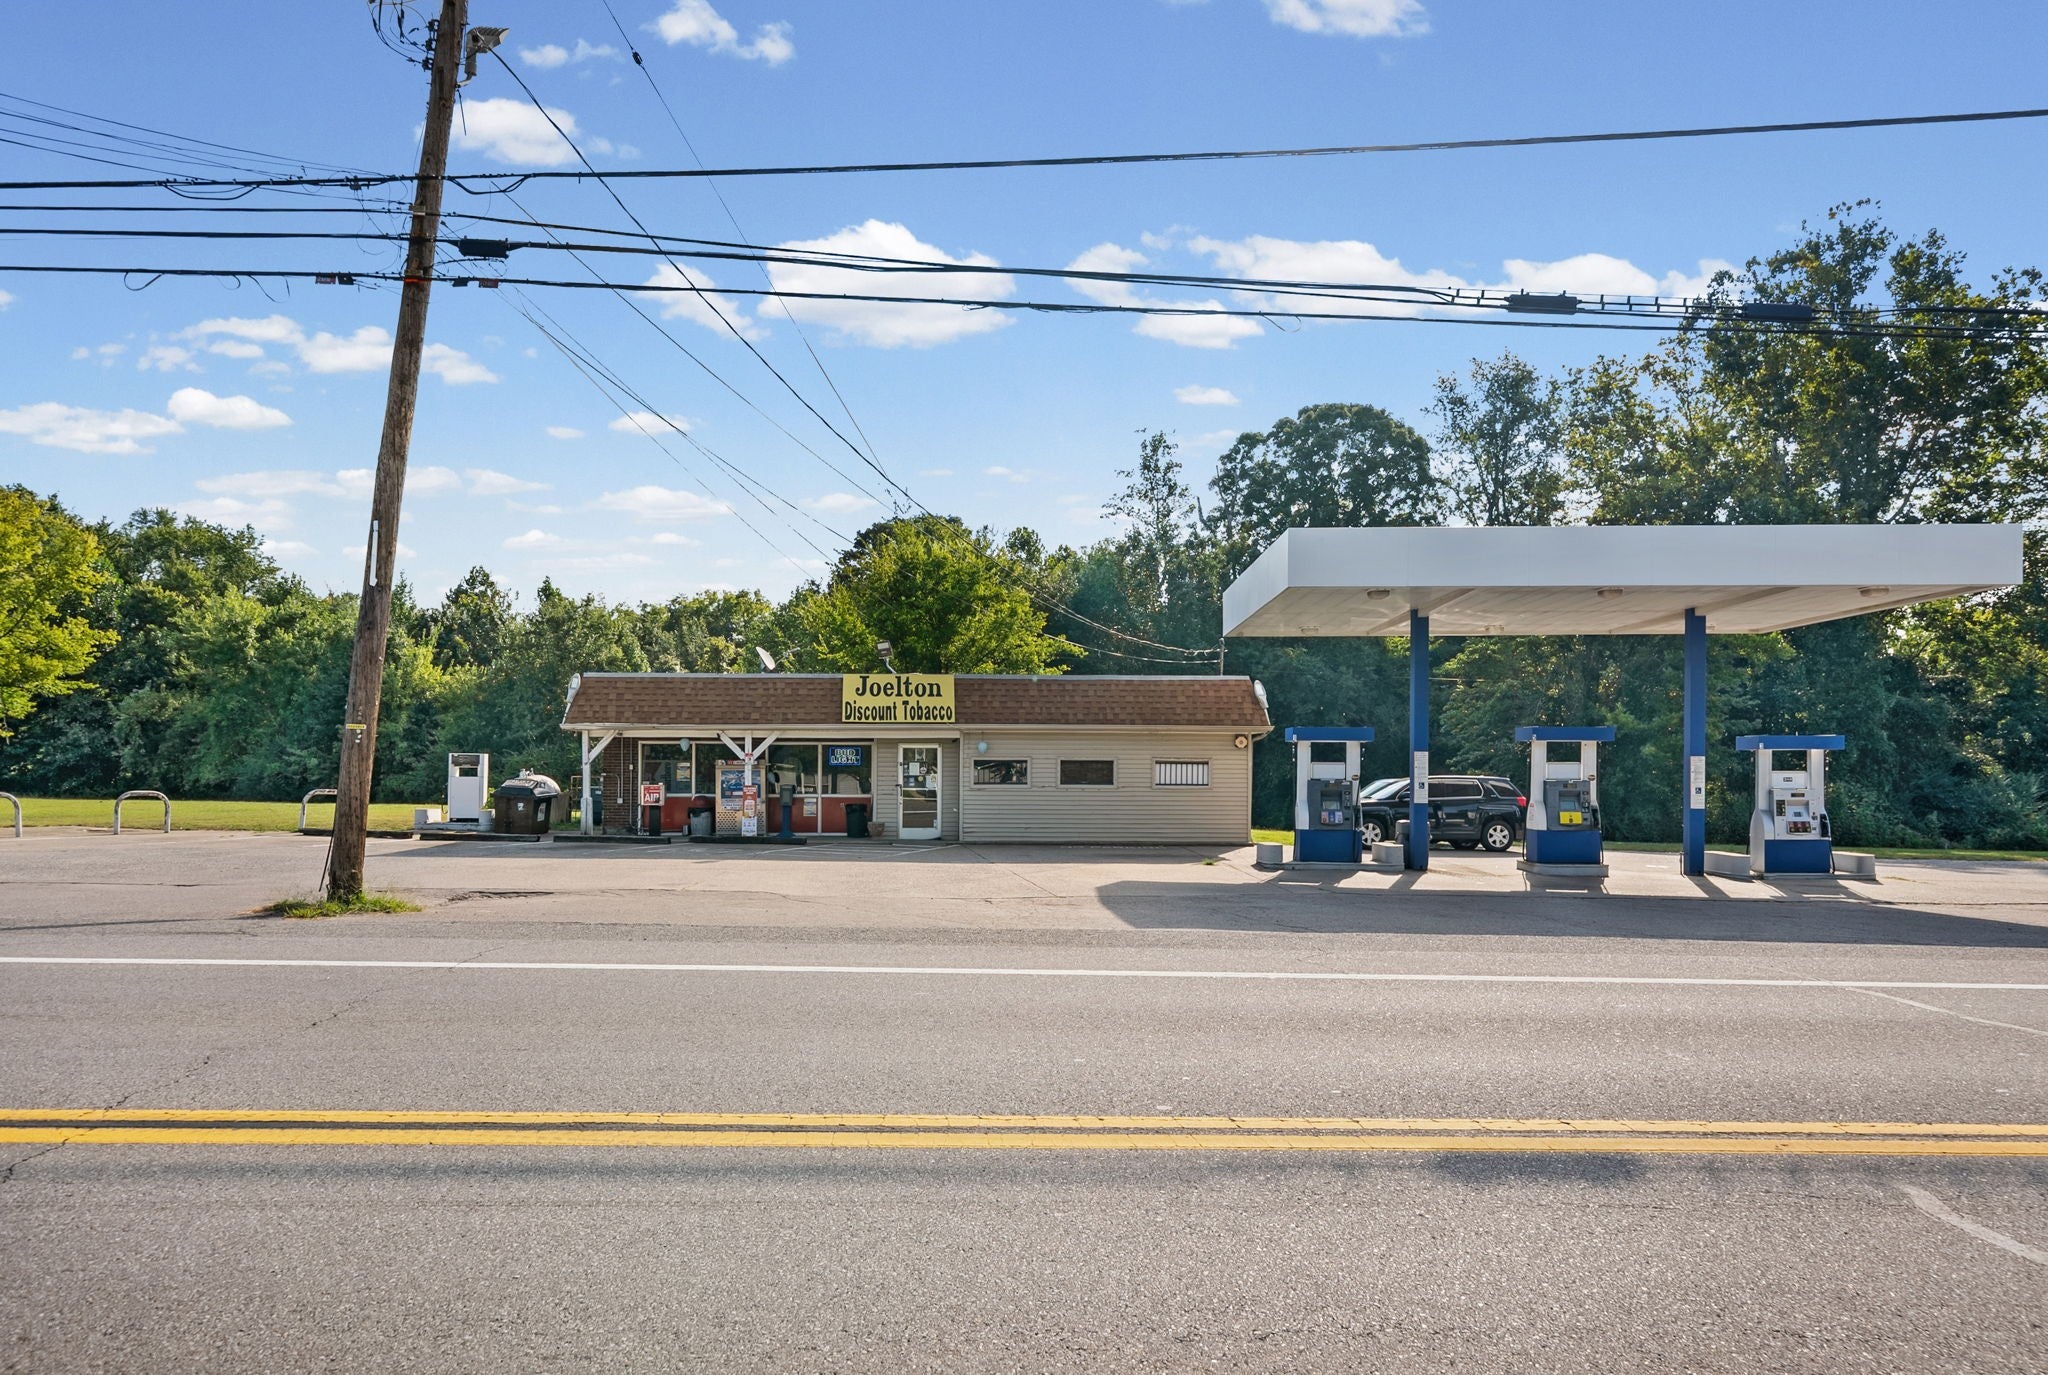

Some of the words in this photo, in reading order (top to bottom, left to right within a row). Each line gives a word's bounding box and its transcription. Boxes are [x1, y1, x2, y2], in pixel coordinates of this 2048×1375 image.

[855, 675, 942, 697] Joelton
[844, 700, 897, 721] Discount
[902, 700, 953, 721] Tobacco
[834, 748, 856, 756] BUD
[831, 755, 860, 764] LIGHT
[644, 793, 660, 802] AIR
